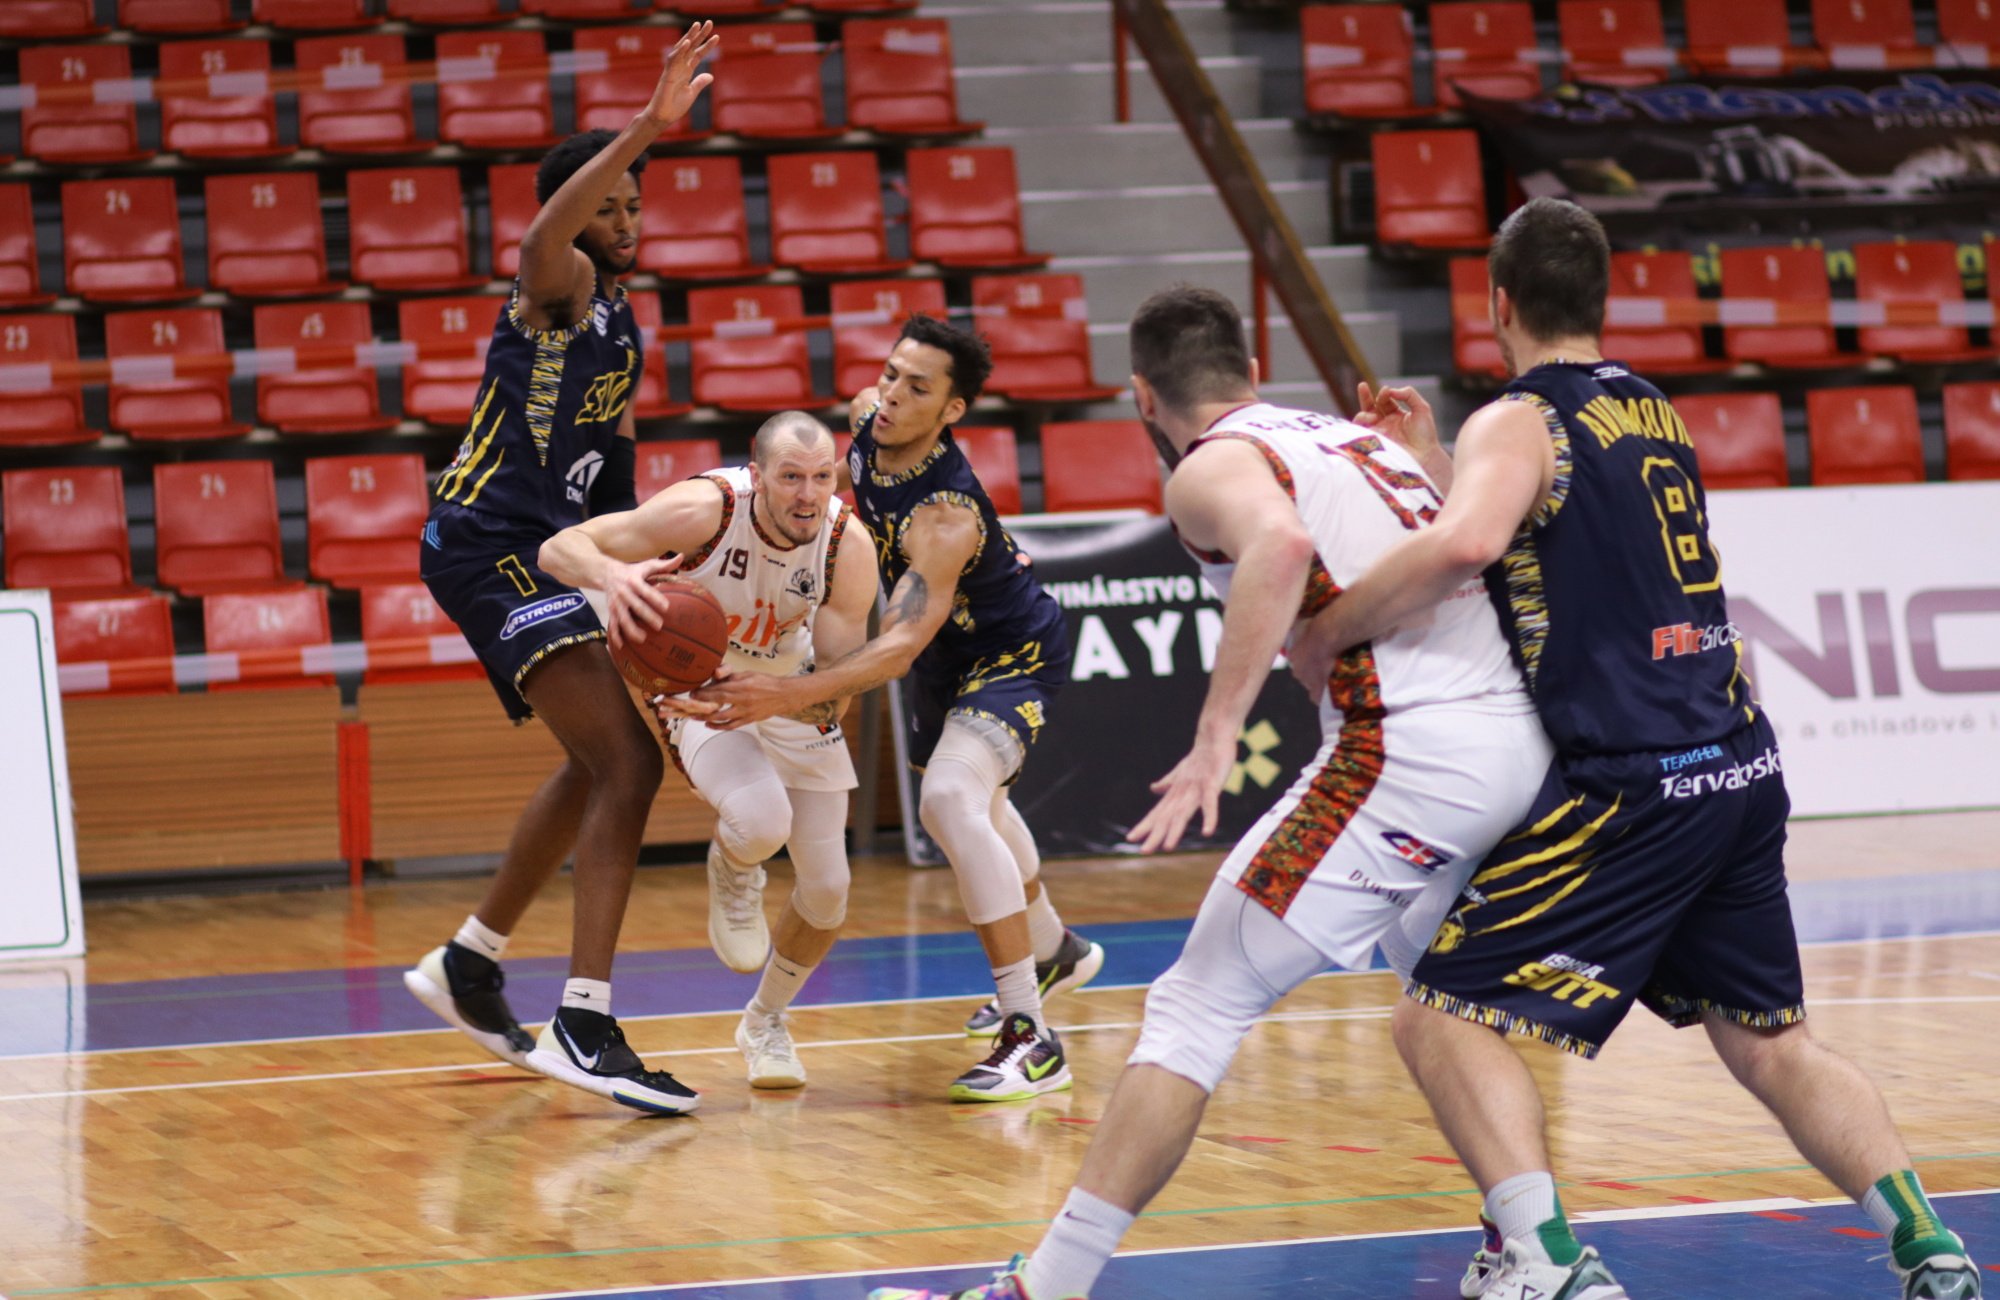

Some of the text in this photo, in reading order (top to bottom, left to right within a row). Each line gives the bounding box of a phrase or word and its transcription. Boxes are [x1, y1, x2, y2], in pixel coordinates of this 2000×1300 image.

[105, 189, 131, 214] 24
[49, 479, 75, 505] 23
[200, 474, 226, 500] 24
[1641, 456, 1723, 594] 8
[496, 553, 539, 598] 1
[718, 546, 749, 581] 19
